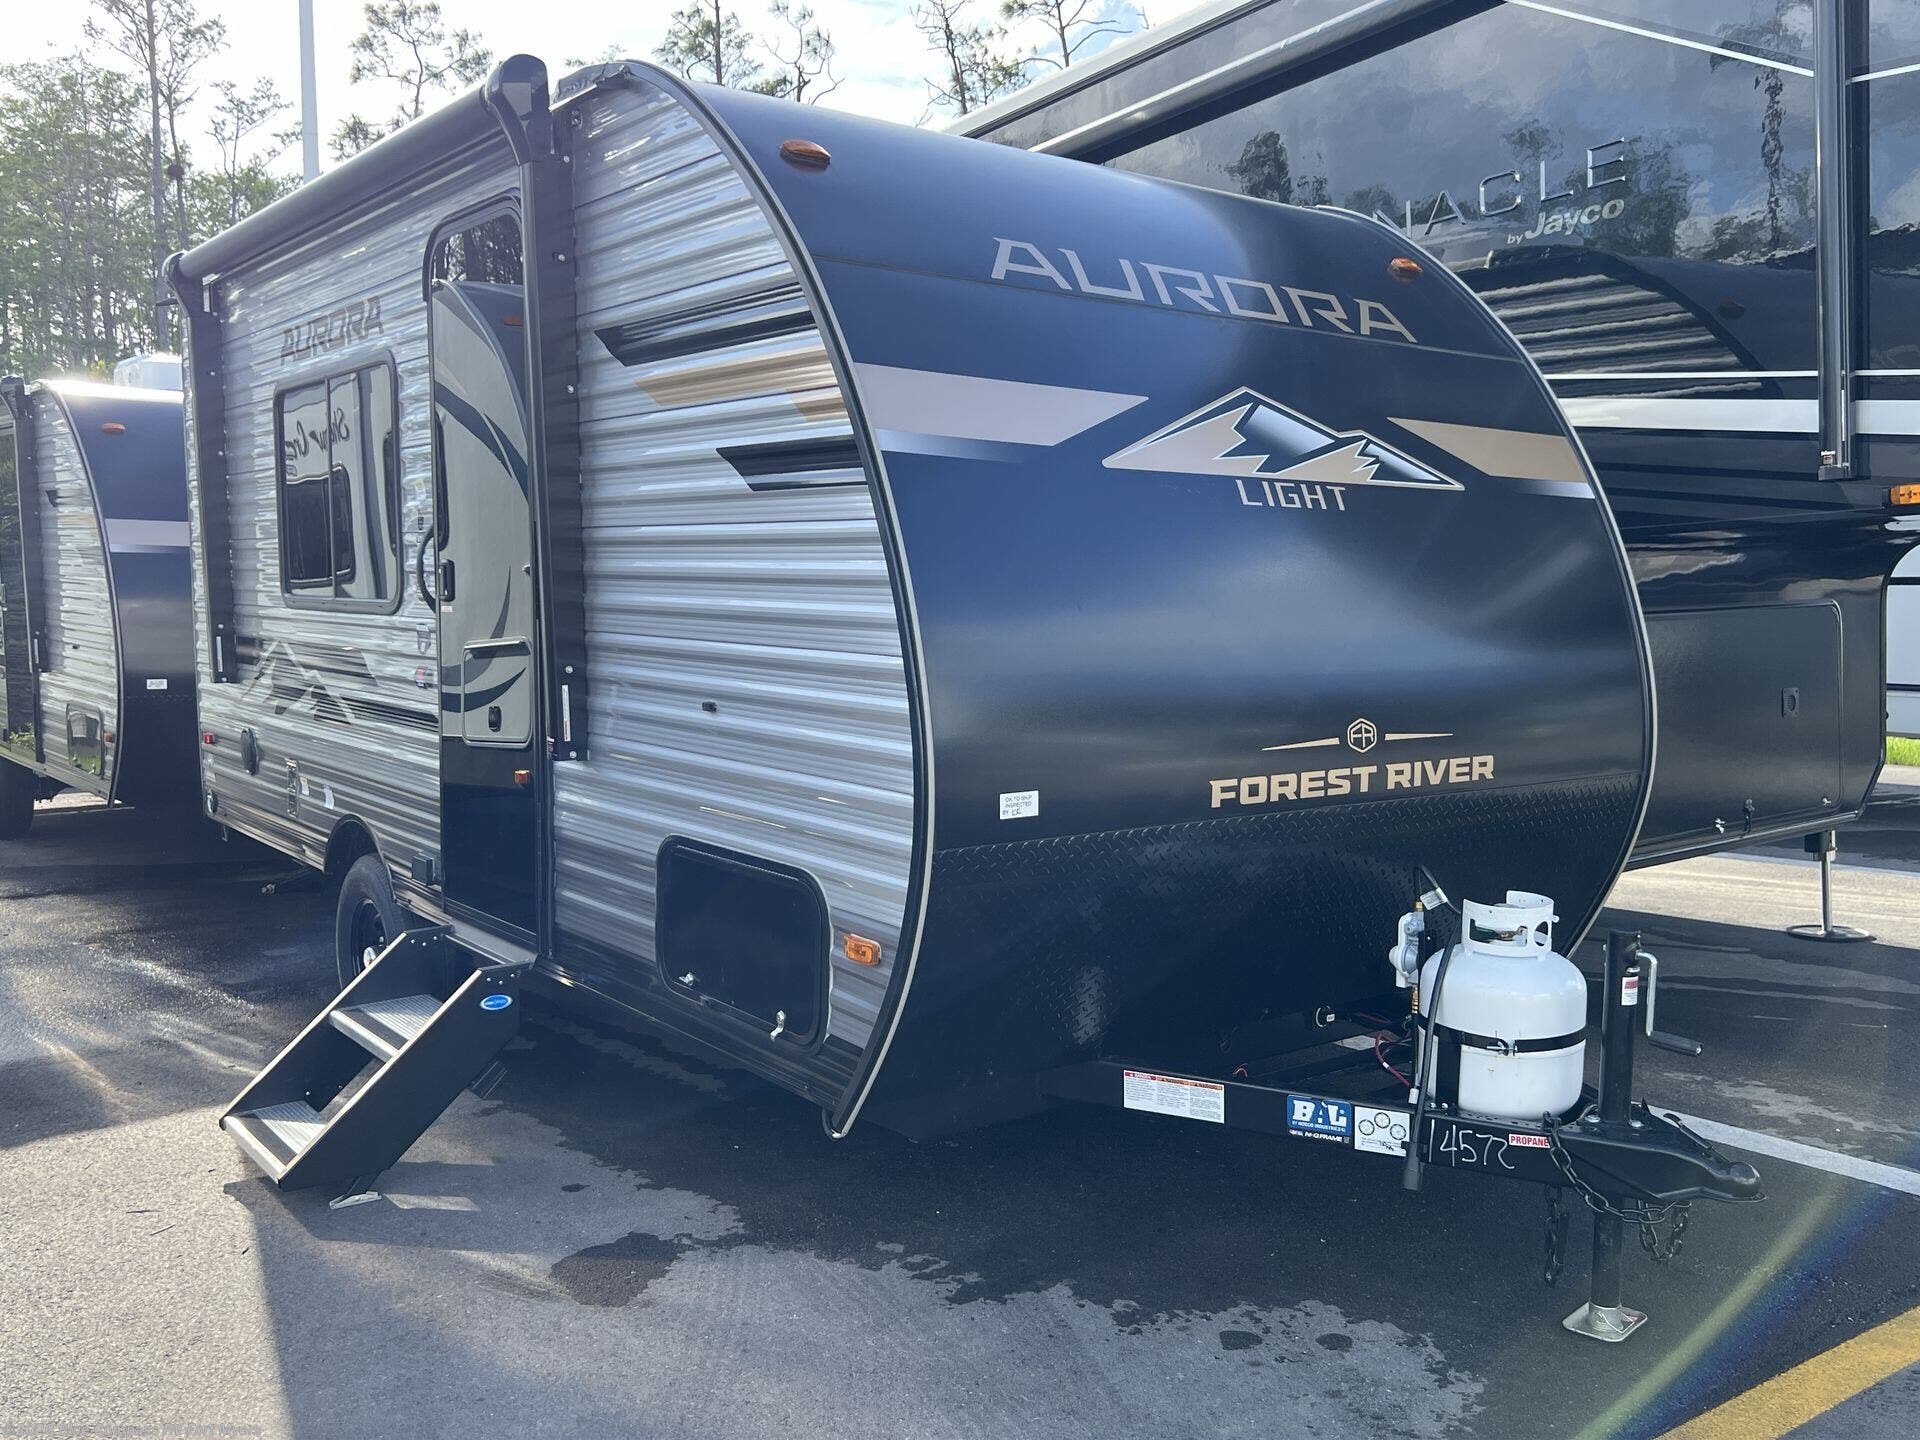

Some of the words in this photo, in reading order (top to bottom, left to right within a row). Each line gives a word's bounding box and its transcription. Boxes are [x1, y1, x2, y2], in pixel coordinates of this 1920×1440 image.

[1506, 232, 1523, 245] by
[1524, 199, 1625, 240] Jayco
[991, 237, 1418, 343] AURORA
[280, 296, 384, 366] AURORA
[1235, 479, 1346, 511] LIGHT
[1209, 765, 1377, 808] FOREST
[1386, 755, 1494, 790] RIVER
[1292, 1100, 1347, 1127] BAL
[1428, 1119, 1515, 1169] 14572
[1510, 1135, 1549, 1147] PROPANE
